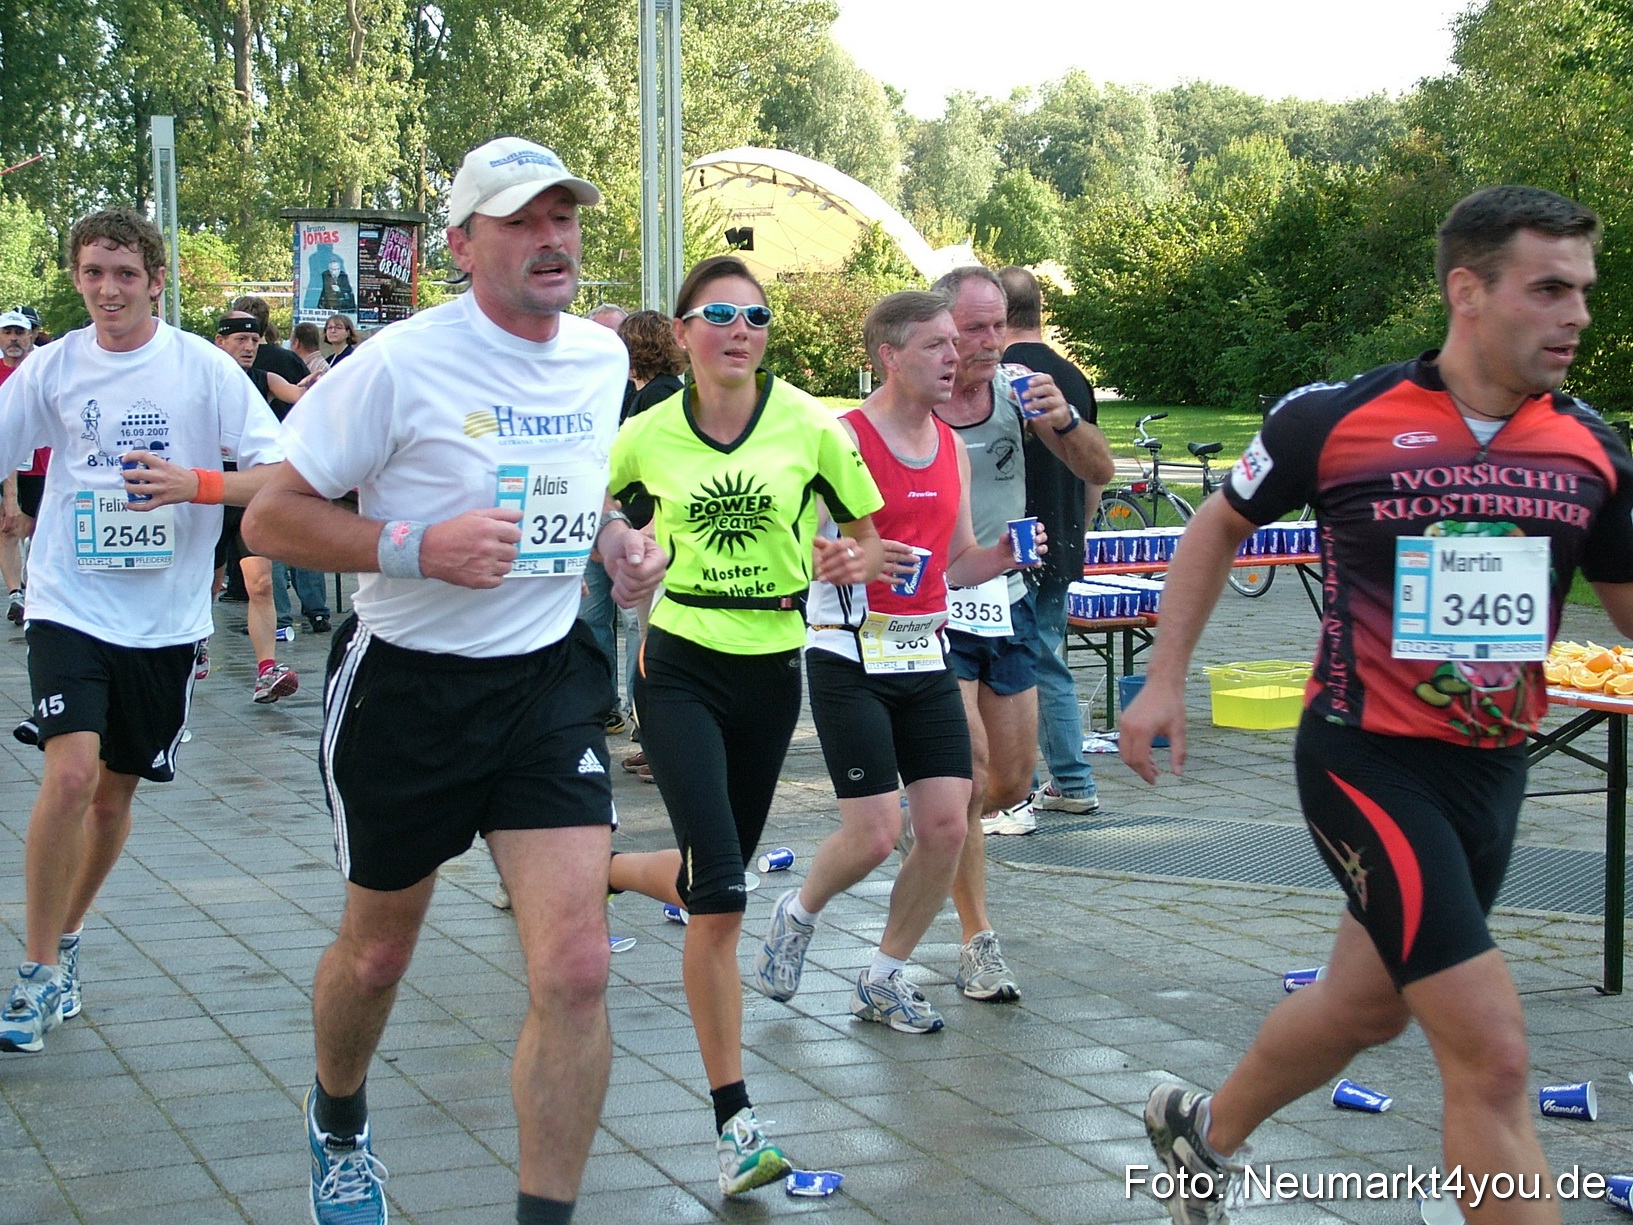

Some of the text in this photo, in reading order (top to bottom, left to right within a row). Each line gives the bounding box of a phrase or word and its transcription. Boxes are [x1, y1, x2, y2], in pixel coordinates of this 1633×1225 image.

[303, 230, 339, 250] Jonas
[492, 405, 593, 437] HÄRTEIS
[121, 427, 169, 437] 16.09.2007
[532, 475, 568, 496] Alois
[1391, 462, 1579, 495] !VORSICHT!
[100, 497, 128, 512] Felix
[689, 494, 773, 519] POWER
[1370, 493, 1592, 530] KLOSTERBIKER
[531, 511, 597, 545] 3243
[708, 515, 758, 530] Team
[79, 521, 167, 548] B 2545
[78, 556, 172, 566] BOCK PFLEIDERER
[1440, 550, 1503, 572] Martin
[702, 565, 769, 582] Kloster-
[951, 601, 1003, 622] 3353
[1403, 585, 1535, 627] B 3469
[888, 619, 933, 633] Gerhard
[38, 693, 65, 719] 15
